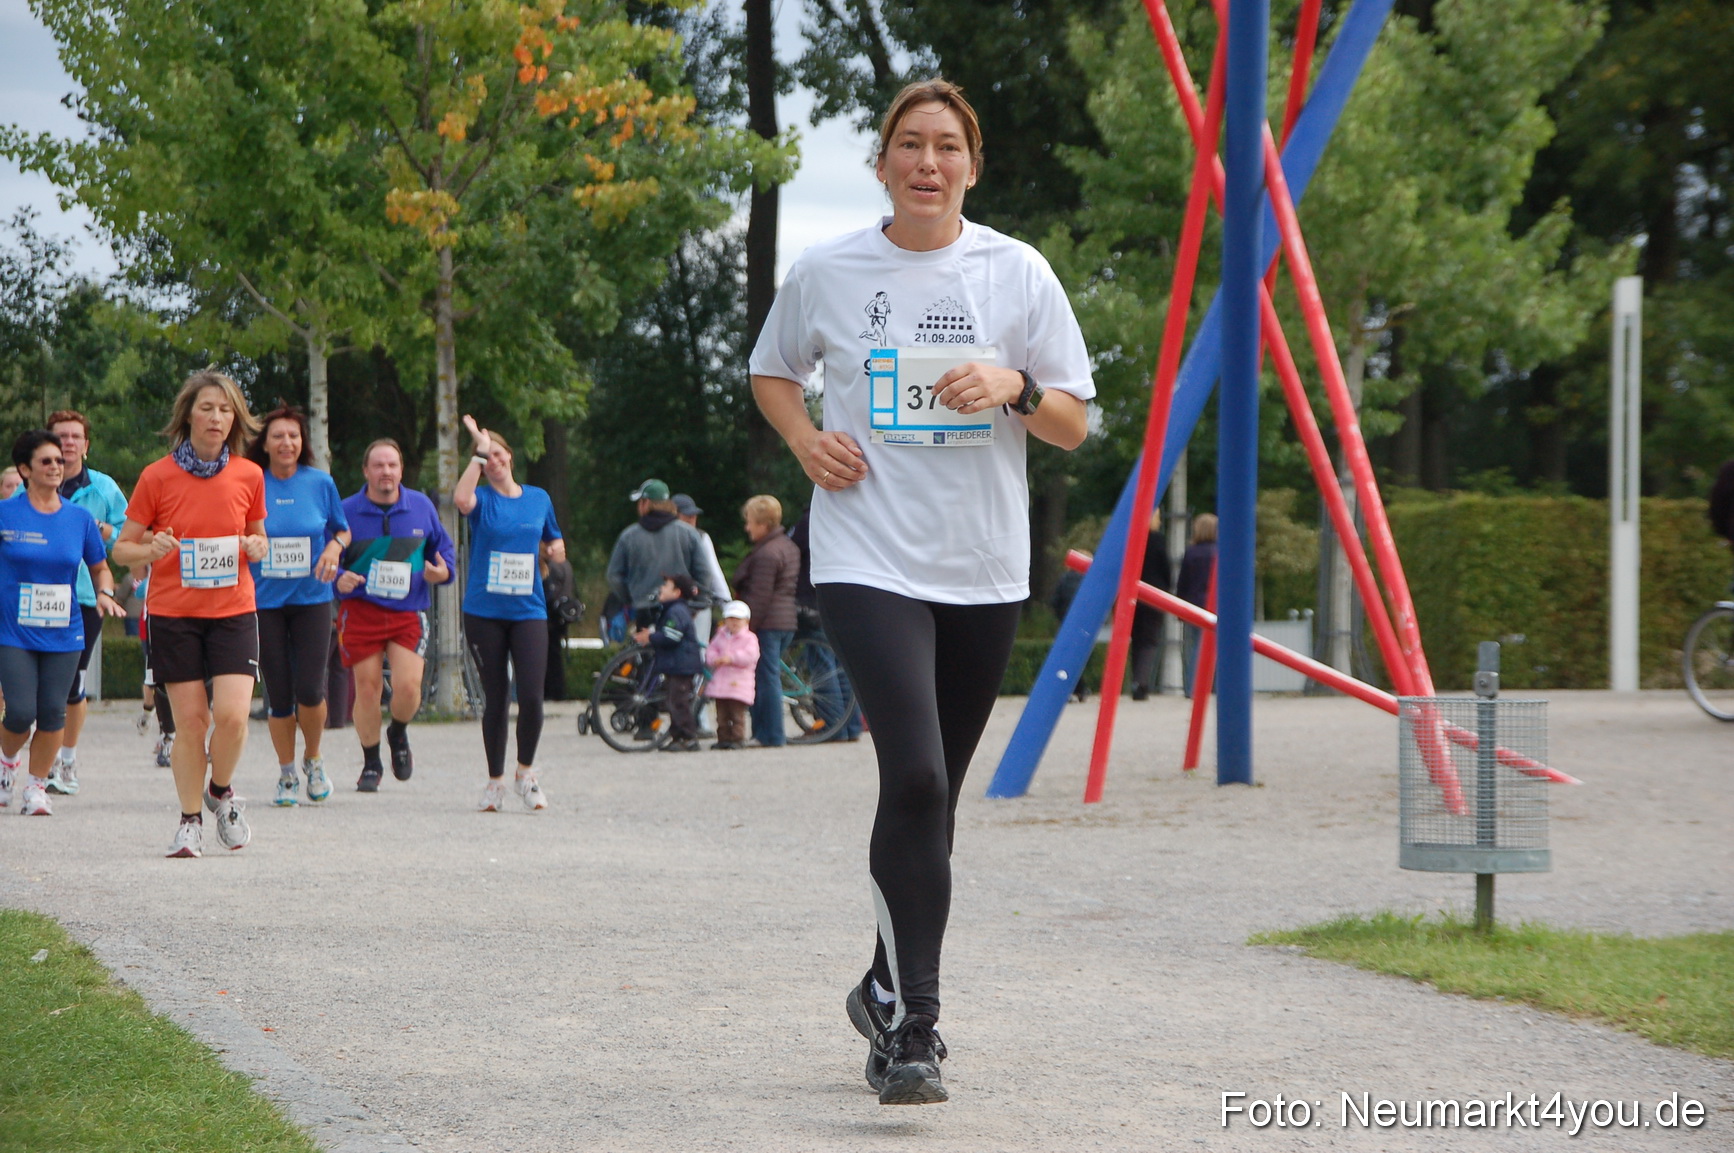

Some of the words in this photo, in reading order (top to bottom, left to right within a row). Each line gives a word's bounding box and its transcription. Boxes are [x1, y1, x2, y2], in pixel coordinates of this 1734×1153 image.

[914, 333, 975, 344] 21.09.2008
[946, 431, 993, 440] PFLEIDERER
[199, 543, 220, 553] Birgit
[200, 555, 234, 570] 2246
[275, 552, 305, 563] 3399
[379, 574, 405, 586] 3308
[35, 601, 66, 612] 3440
